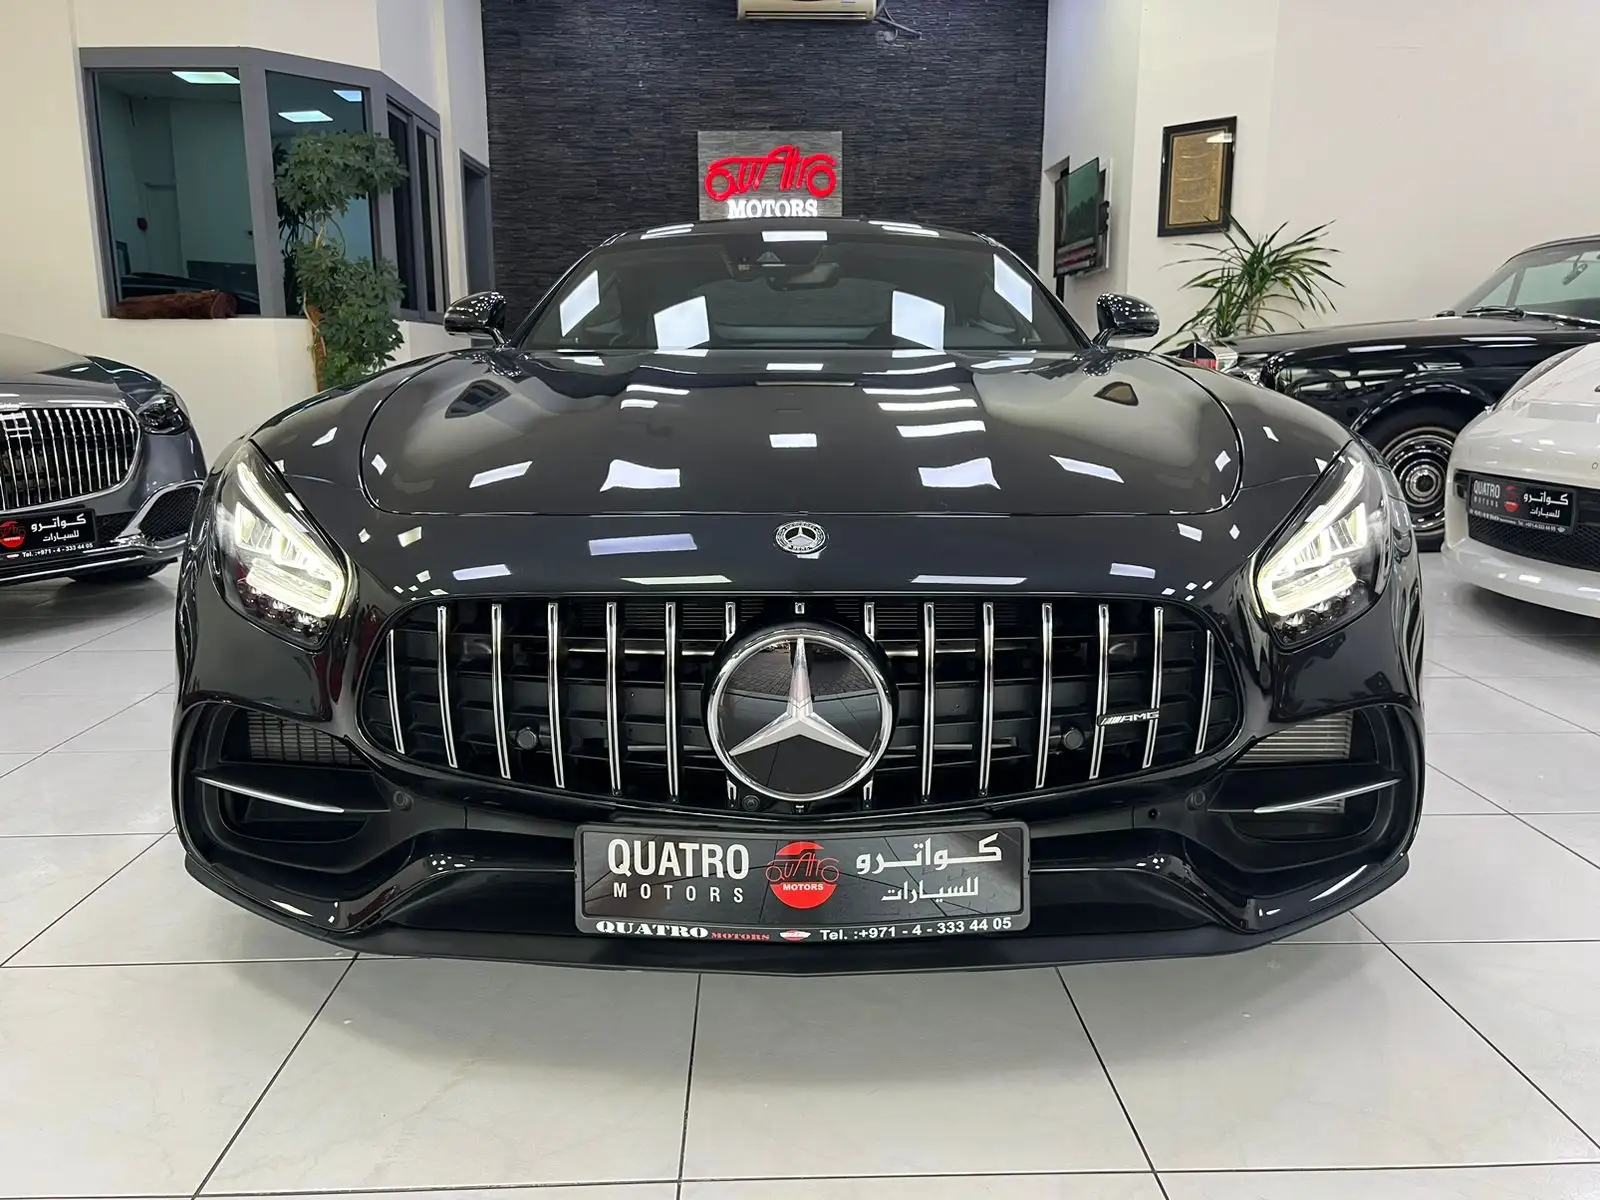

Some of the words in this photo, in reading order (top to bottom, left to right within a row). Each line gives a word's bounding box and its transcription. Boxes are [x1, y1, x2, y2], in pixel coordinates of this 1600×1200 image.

[727, 199, 818, 219] MOTORS
[1473, 480, 1500, 499] QUATRO
[30, 513, 87, 532] كواترو
[1121, 711, 1160, 723] AMG
[607, 838, 750, 880] QUATRO
[855, 832, 1003, 875] كواترو
[613, 882, 744, 903] MOTORS
[782, 883, 824, 891] MOTORS
[881, 876, 979, 904] للسيارات
[595, 920, 709, 938] QUATRO
[711, 932, 770, 941] MOTORS
[819, 929, 848, 941] Tel.
[911, 924, 922, 936] 4
[936, 920, 965, 934] 333
[969, 919, 989, 931] 44
[993, 916, 1012, 930] 05
